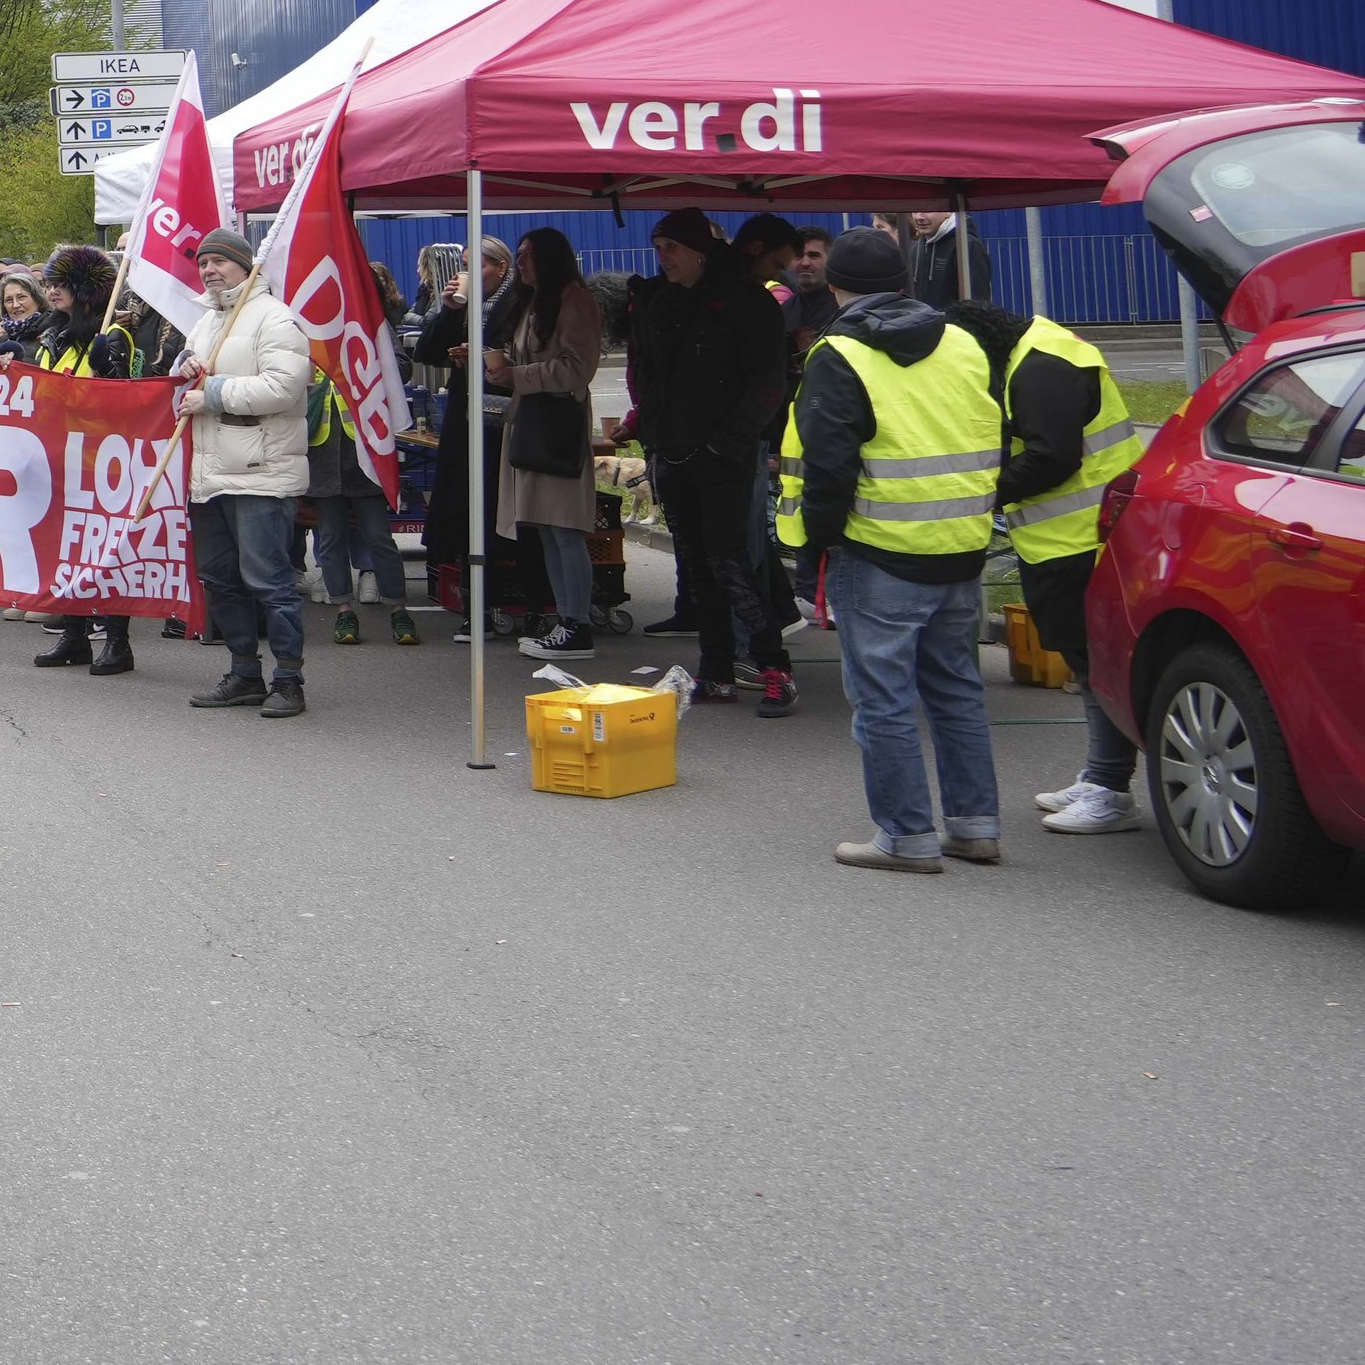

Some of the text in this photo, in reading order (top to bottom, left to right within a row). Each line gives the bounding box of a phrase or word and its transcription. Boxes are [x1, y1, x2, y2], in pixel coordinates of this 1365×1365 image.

[100, 58, 141, 74] IKEA
[569, 87, 822, 152] ver.di
[289, 254, 396, 456] DGB
